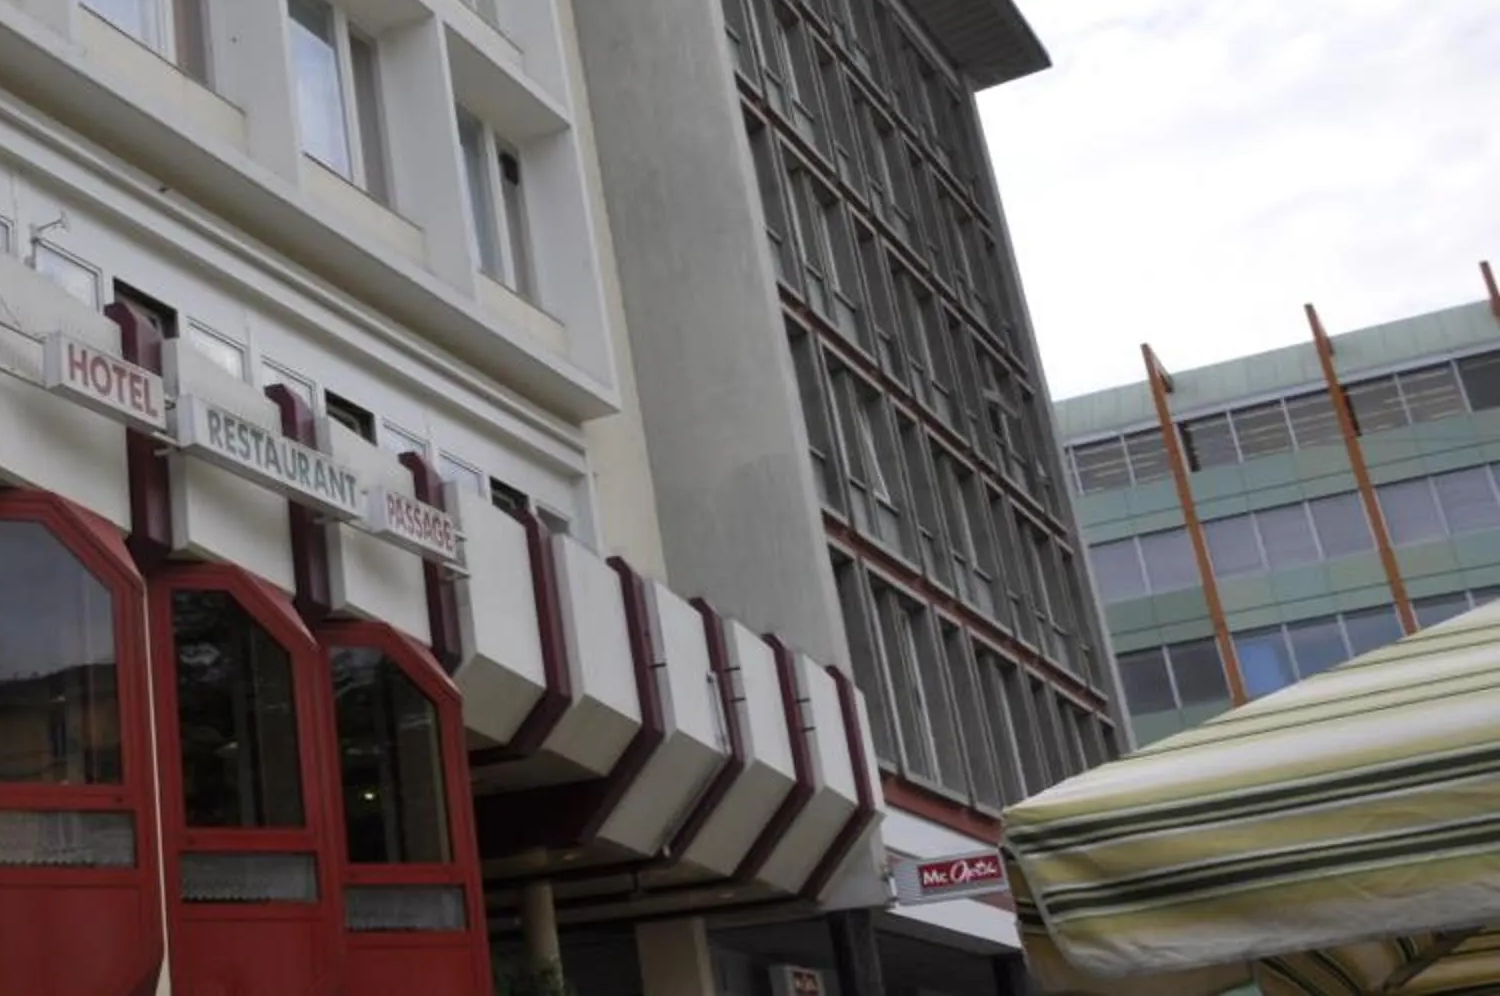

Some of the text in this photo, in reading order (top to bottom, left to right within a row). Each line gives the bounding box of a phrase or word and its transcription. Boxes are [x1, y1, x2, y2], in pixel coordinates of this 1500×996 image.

[68, 343, 160, 418] HOTEL
[207, 408, 358, 509] RESTAURANT
[387, 492, 455, 552] PASSAGE
